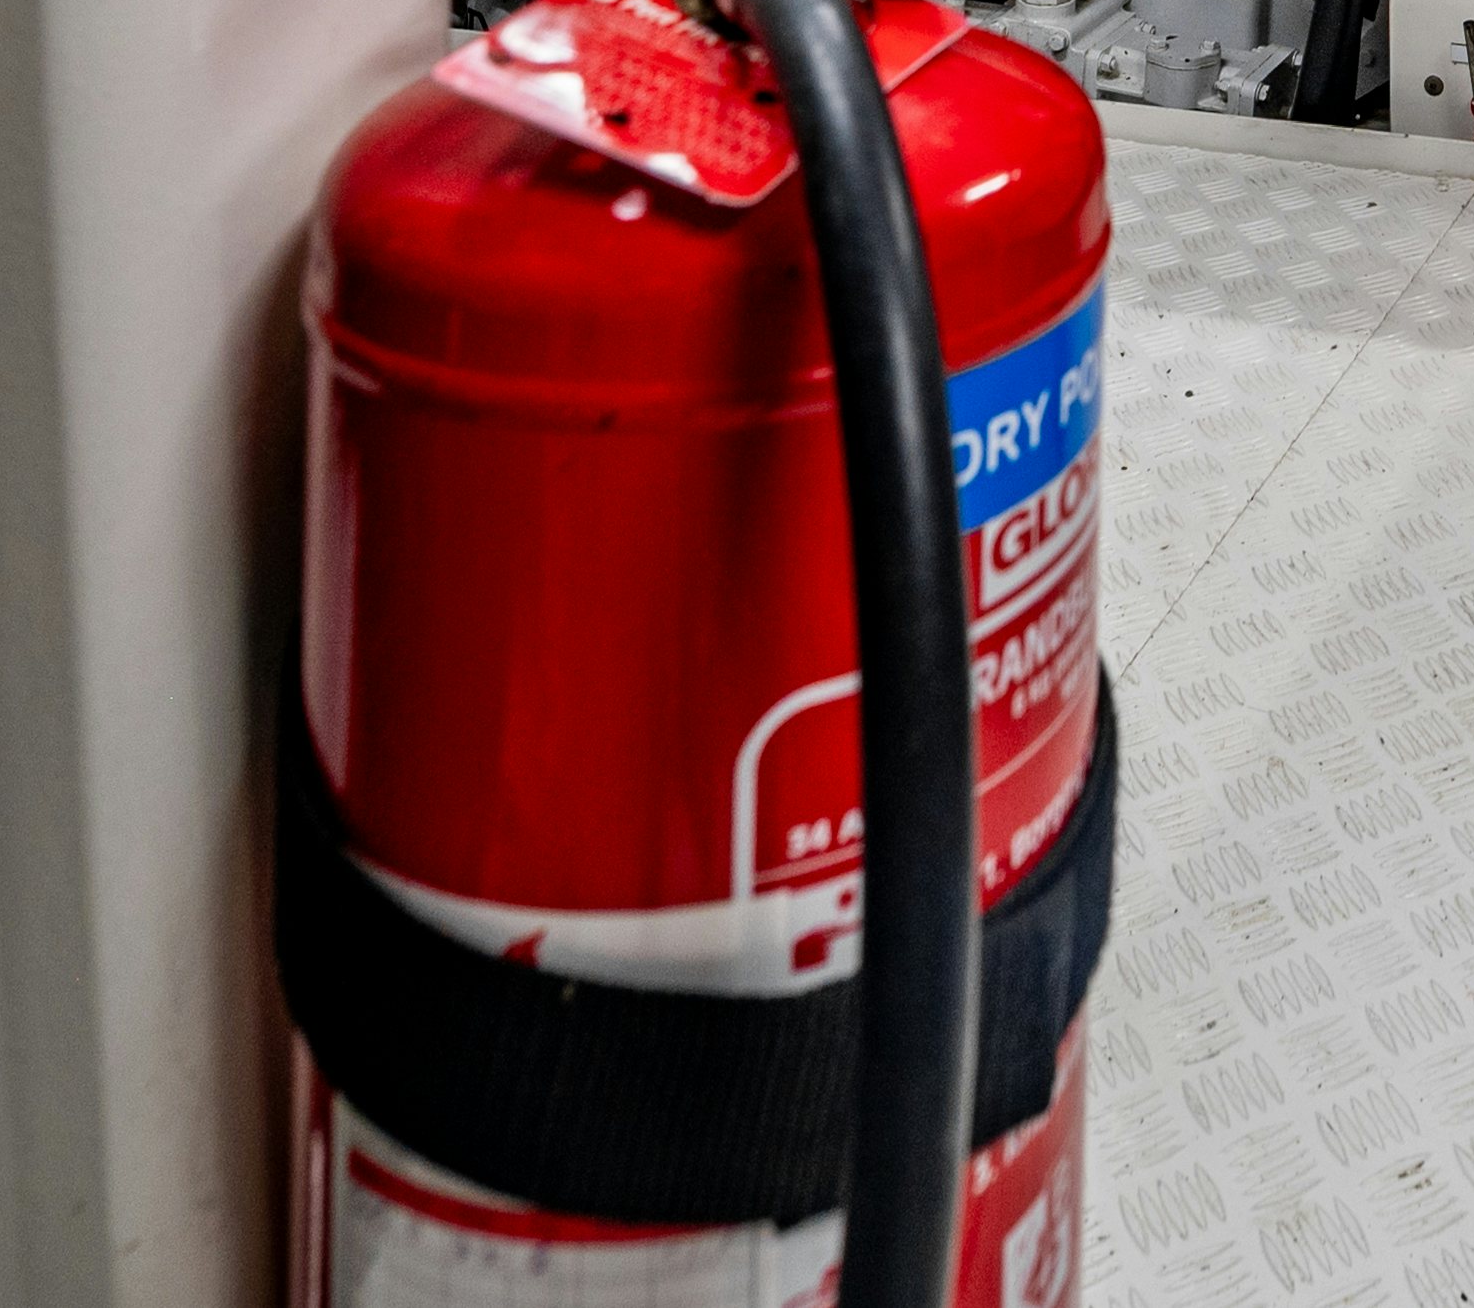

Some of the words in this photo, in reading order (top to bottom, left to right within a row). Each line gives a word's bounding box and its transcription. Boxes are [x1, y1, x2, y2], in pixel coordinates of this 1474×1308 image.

[951, 389, 1049, 487] DRY
[991, 460, 1093, 572] GLO
[786, 818, 833, 860] 34
